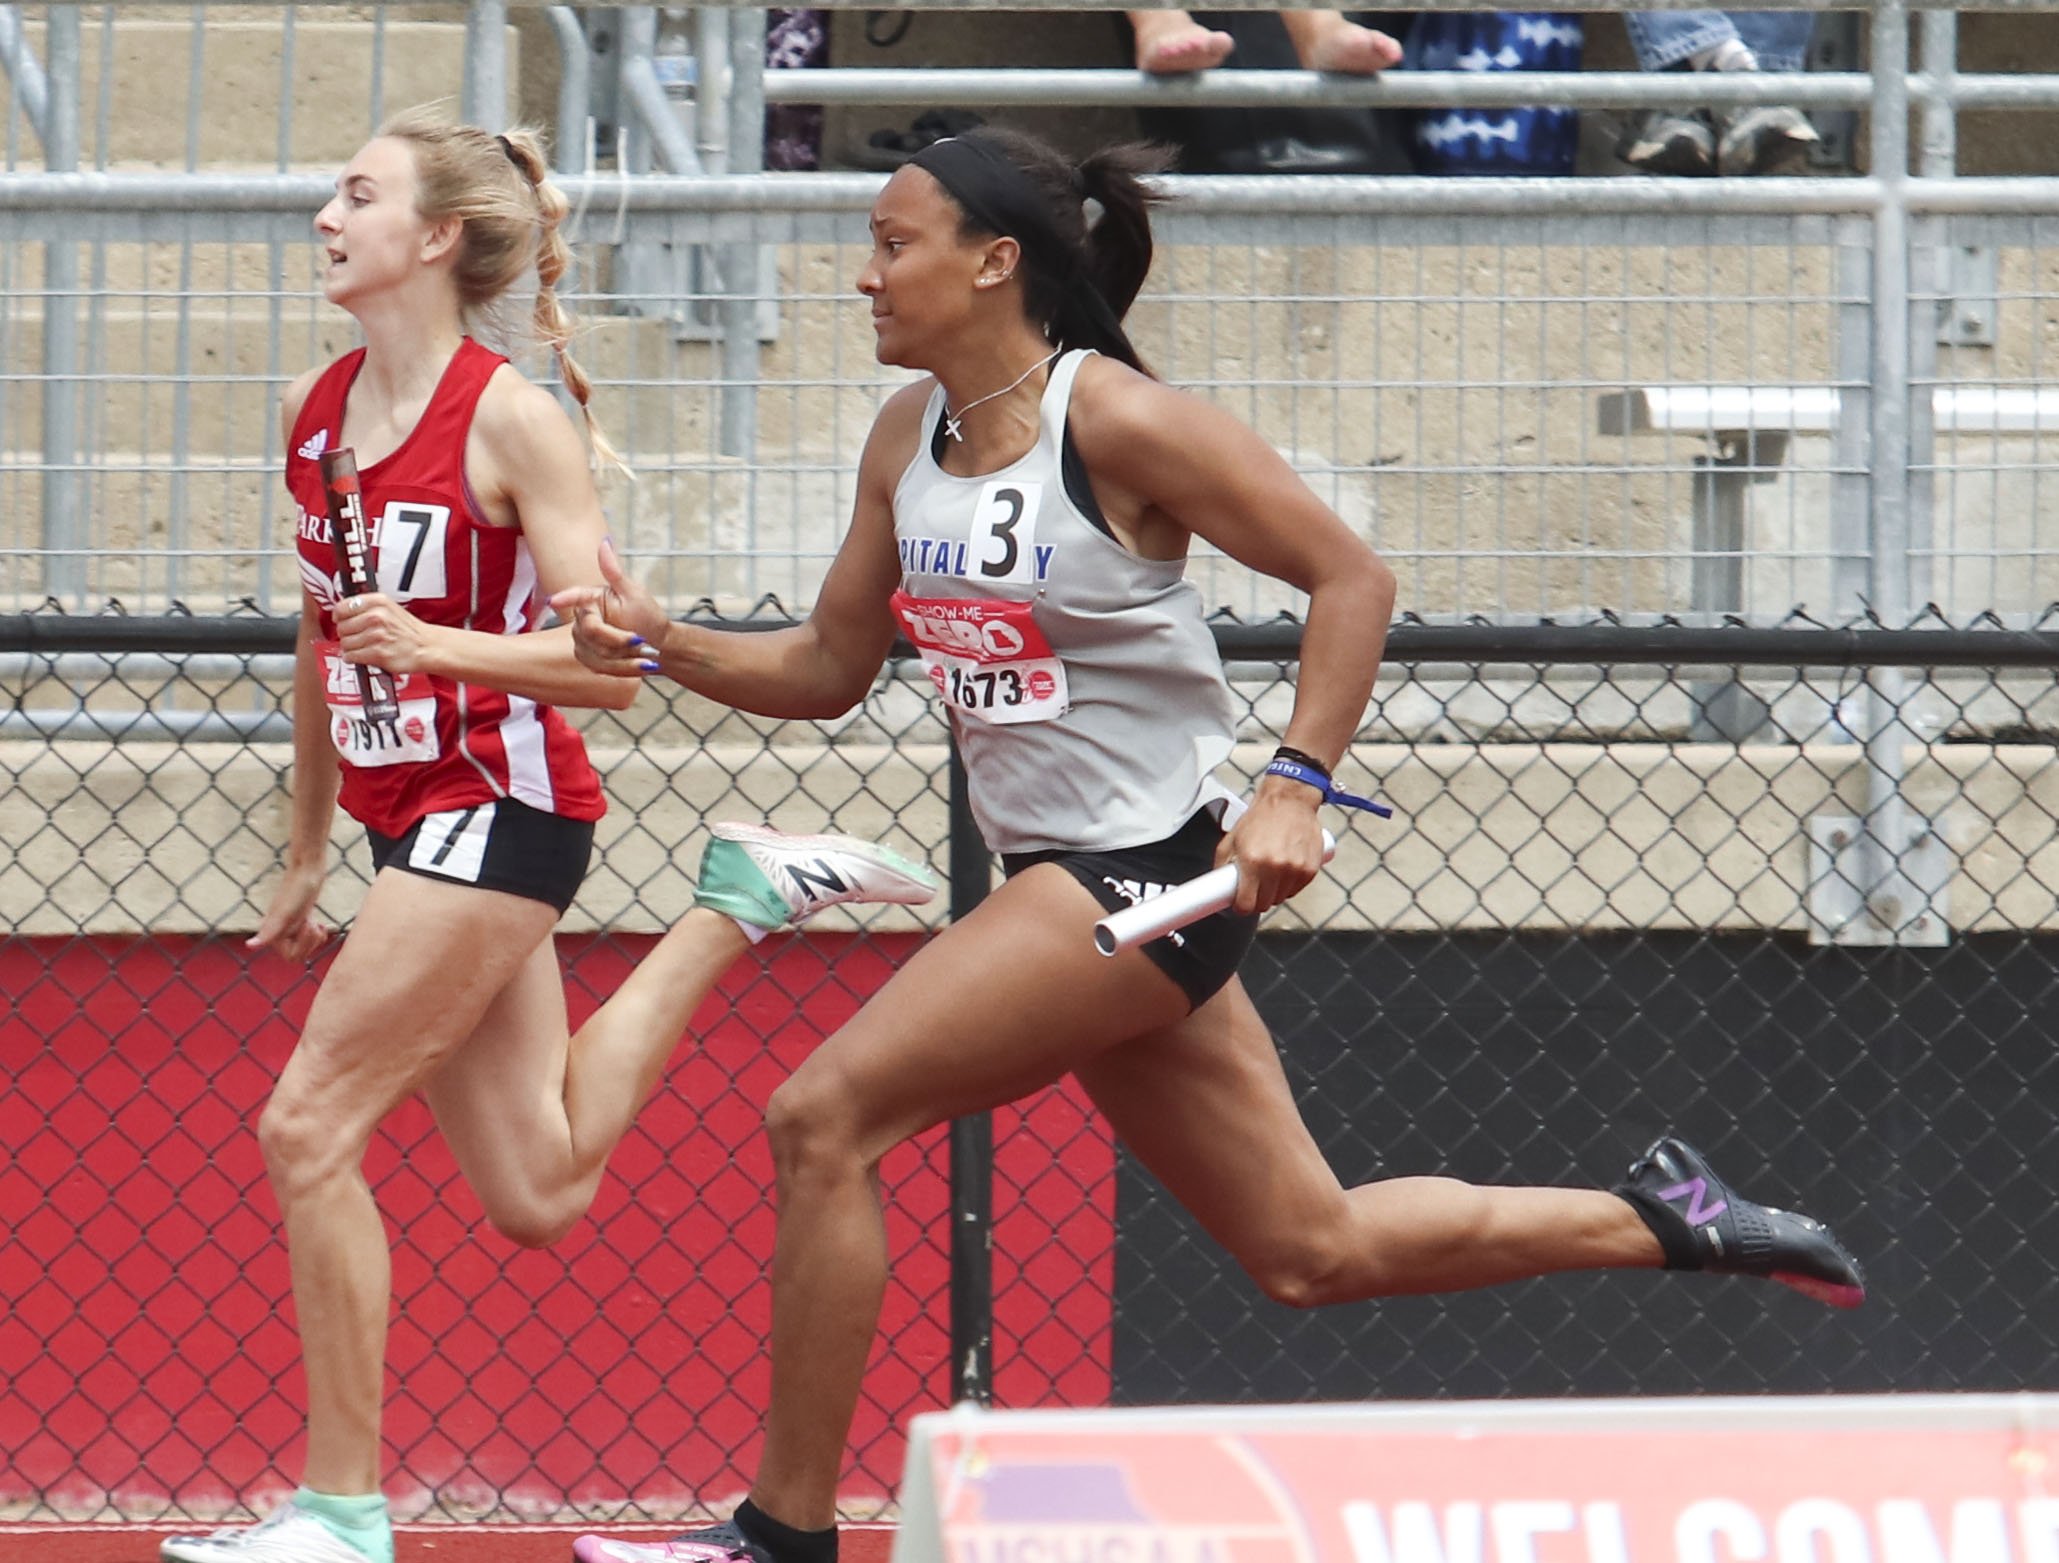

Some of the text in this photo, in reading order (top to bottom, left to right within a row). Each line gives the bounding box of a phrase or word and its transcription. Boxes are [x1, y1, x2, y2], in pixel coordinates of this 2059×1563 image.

[398, 510, 432, 592] 7
[980, 488, 1024, 578] 3
[901, 609, 1024, 657] ZERO
[916, 603, 984, 621] SHOW-ME
[951, 667, 1023, 710] 1673
[1342, 1498, 2059, 1563] WELCOM
